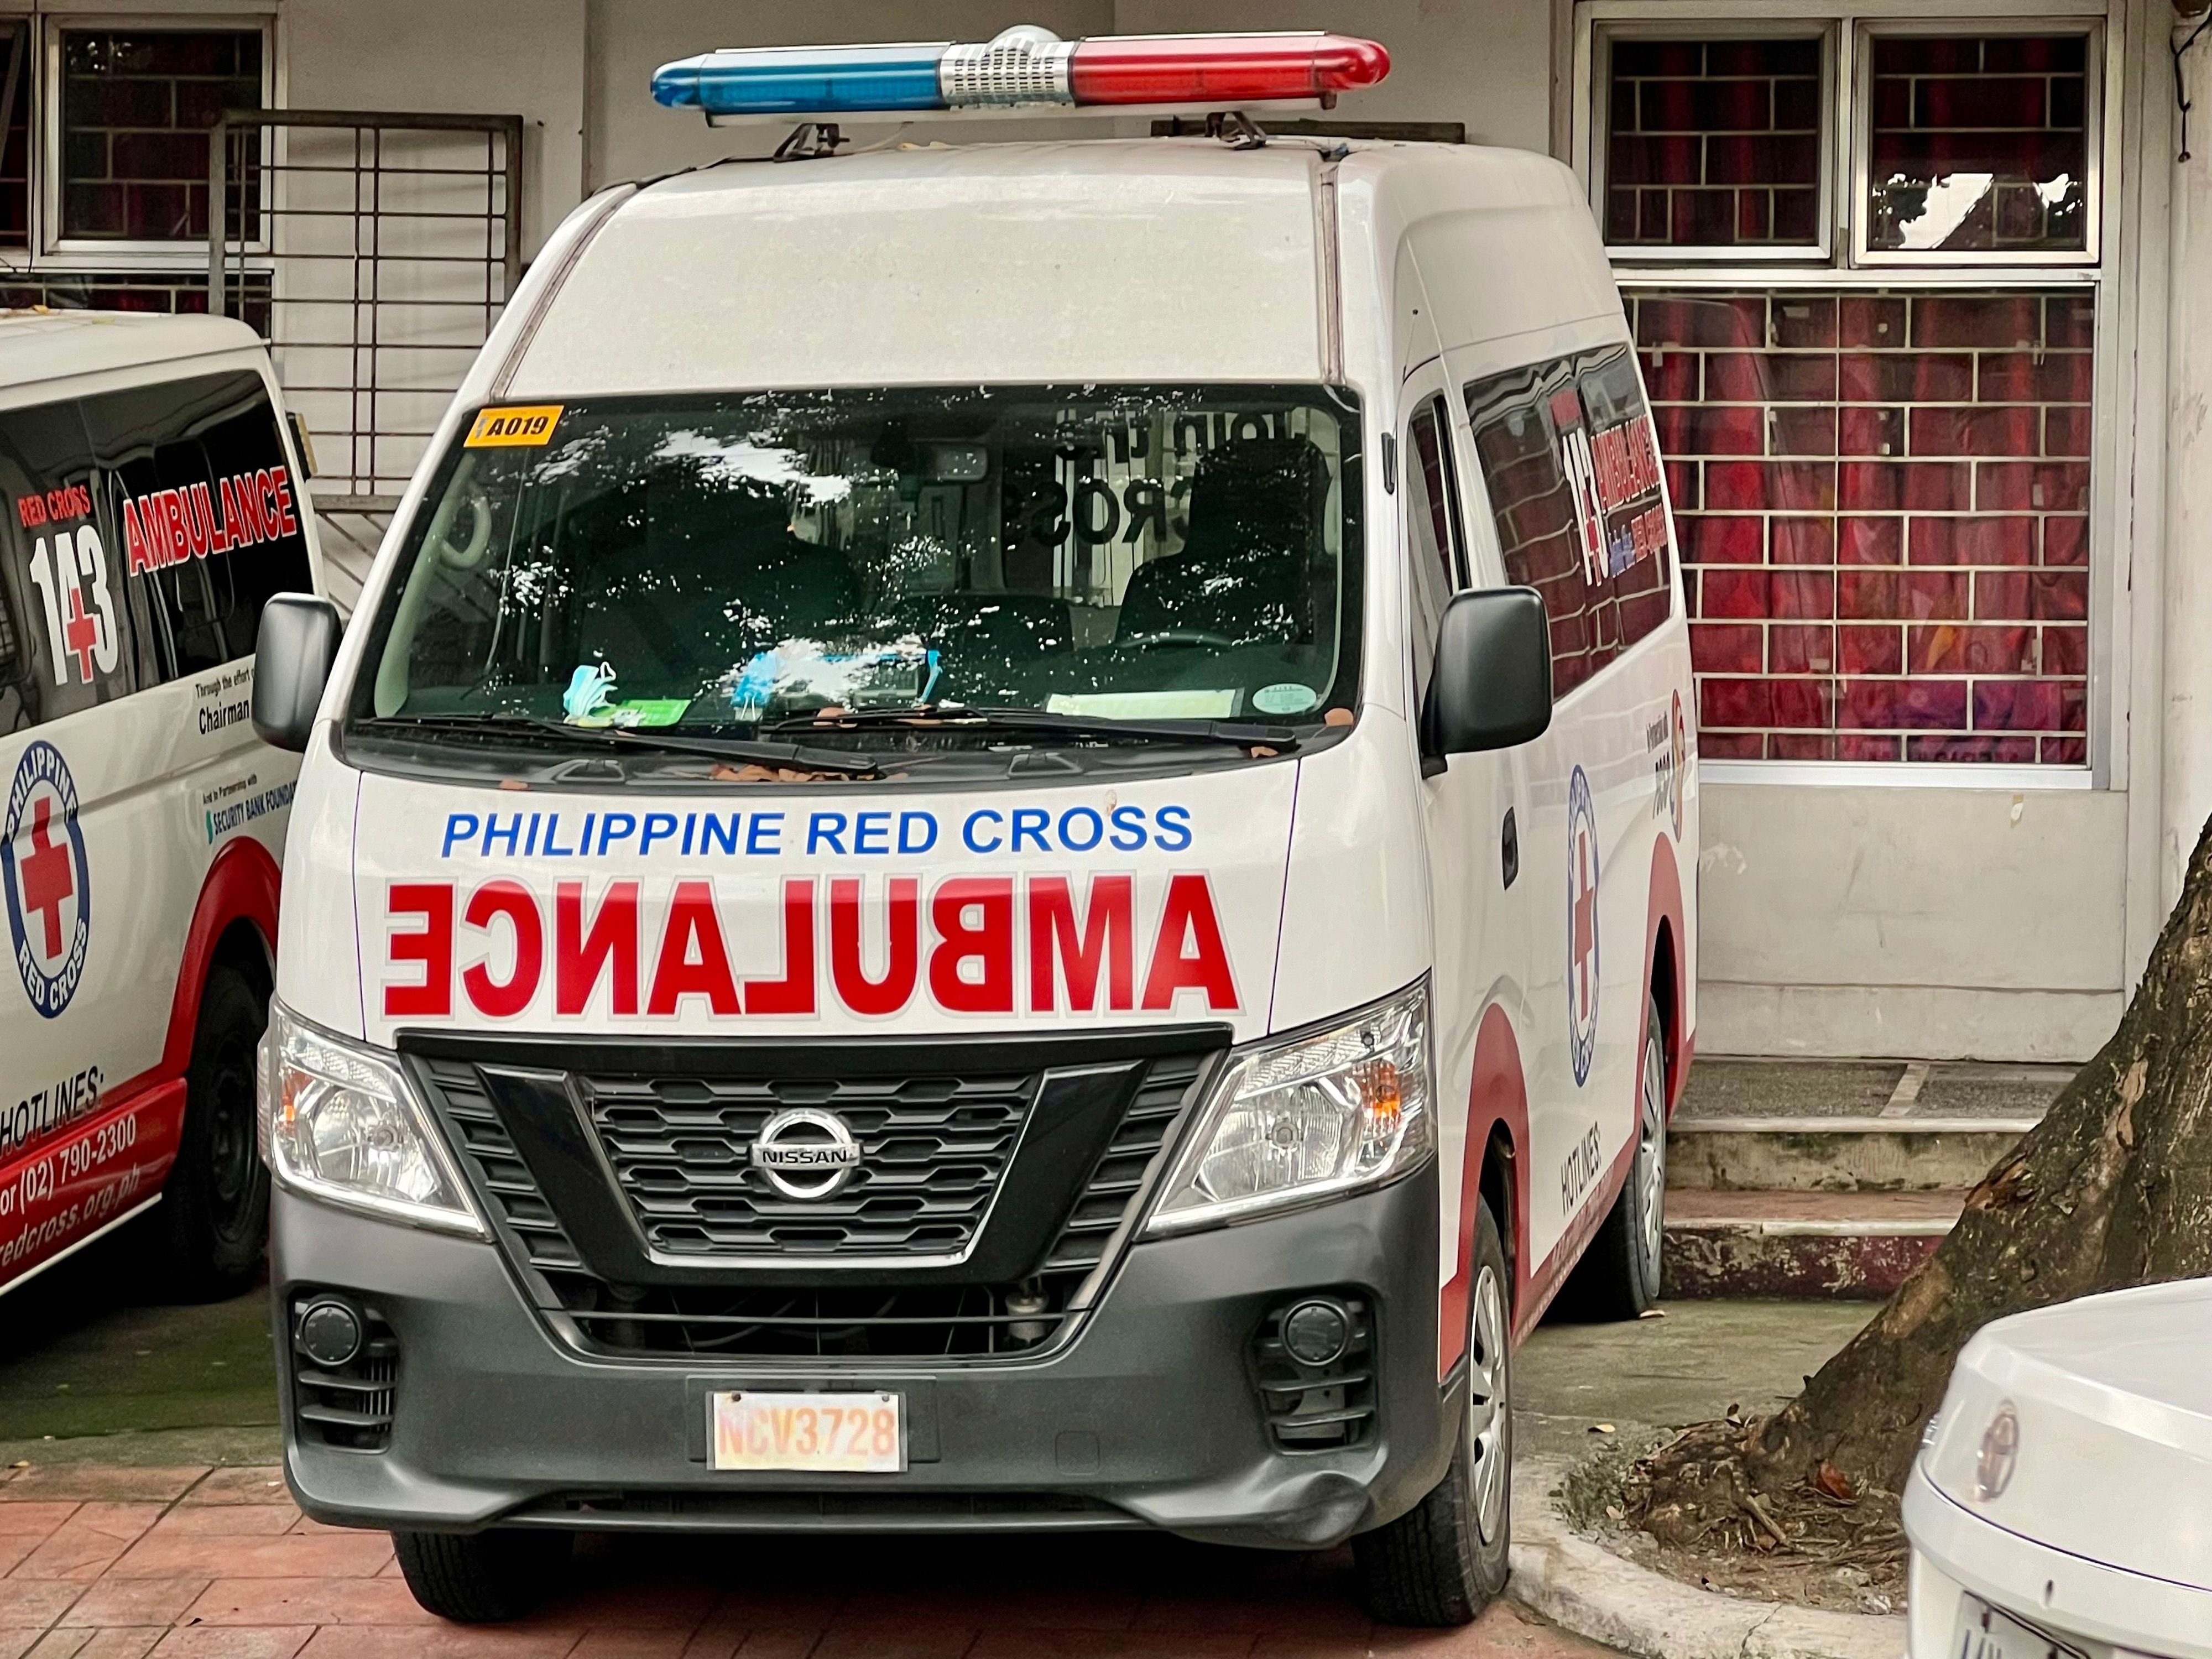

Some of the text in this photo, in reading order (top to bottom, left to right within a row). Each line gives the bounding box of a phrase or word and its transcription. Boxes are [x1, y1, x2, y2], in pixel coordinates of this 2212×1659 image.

[486, 416, 549, 436] A019
[18, 484, 91, 528] RED CROSS
[123, 465, 297, 577] AMBULANCE
[29, 525, 118, 686] 143
[199, 700, 249, 734] Chairman
[7, 747, 77, 843] PHILIPPINE
[213, 802, 244, 835] SECURITY
[246, 794, 266, 821] BANK
[442, 805, 1193, 858] PHILIPPINE RED CROSS
[19, 917, 87, 1010] RED CROSS
[0, 1113, 137, 1215] or (02) 790-2300
[763, 1150, 847, 1164] NISSAN
[719, 1407, 895, 1457] NCV3728
